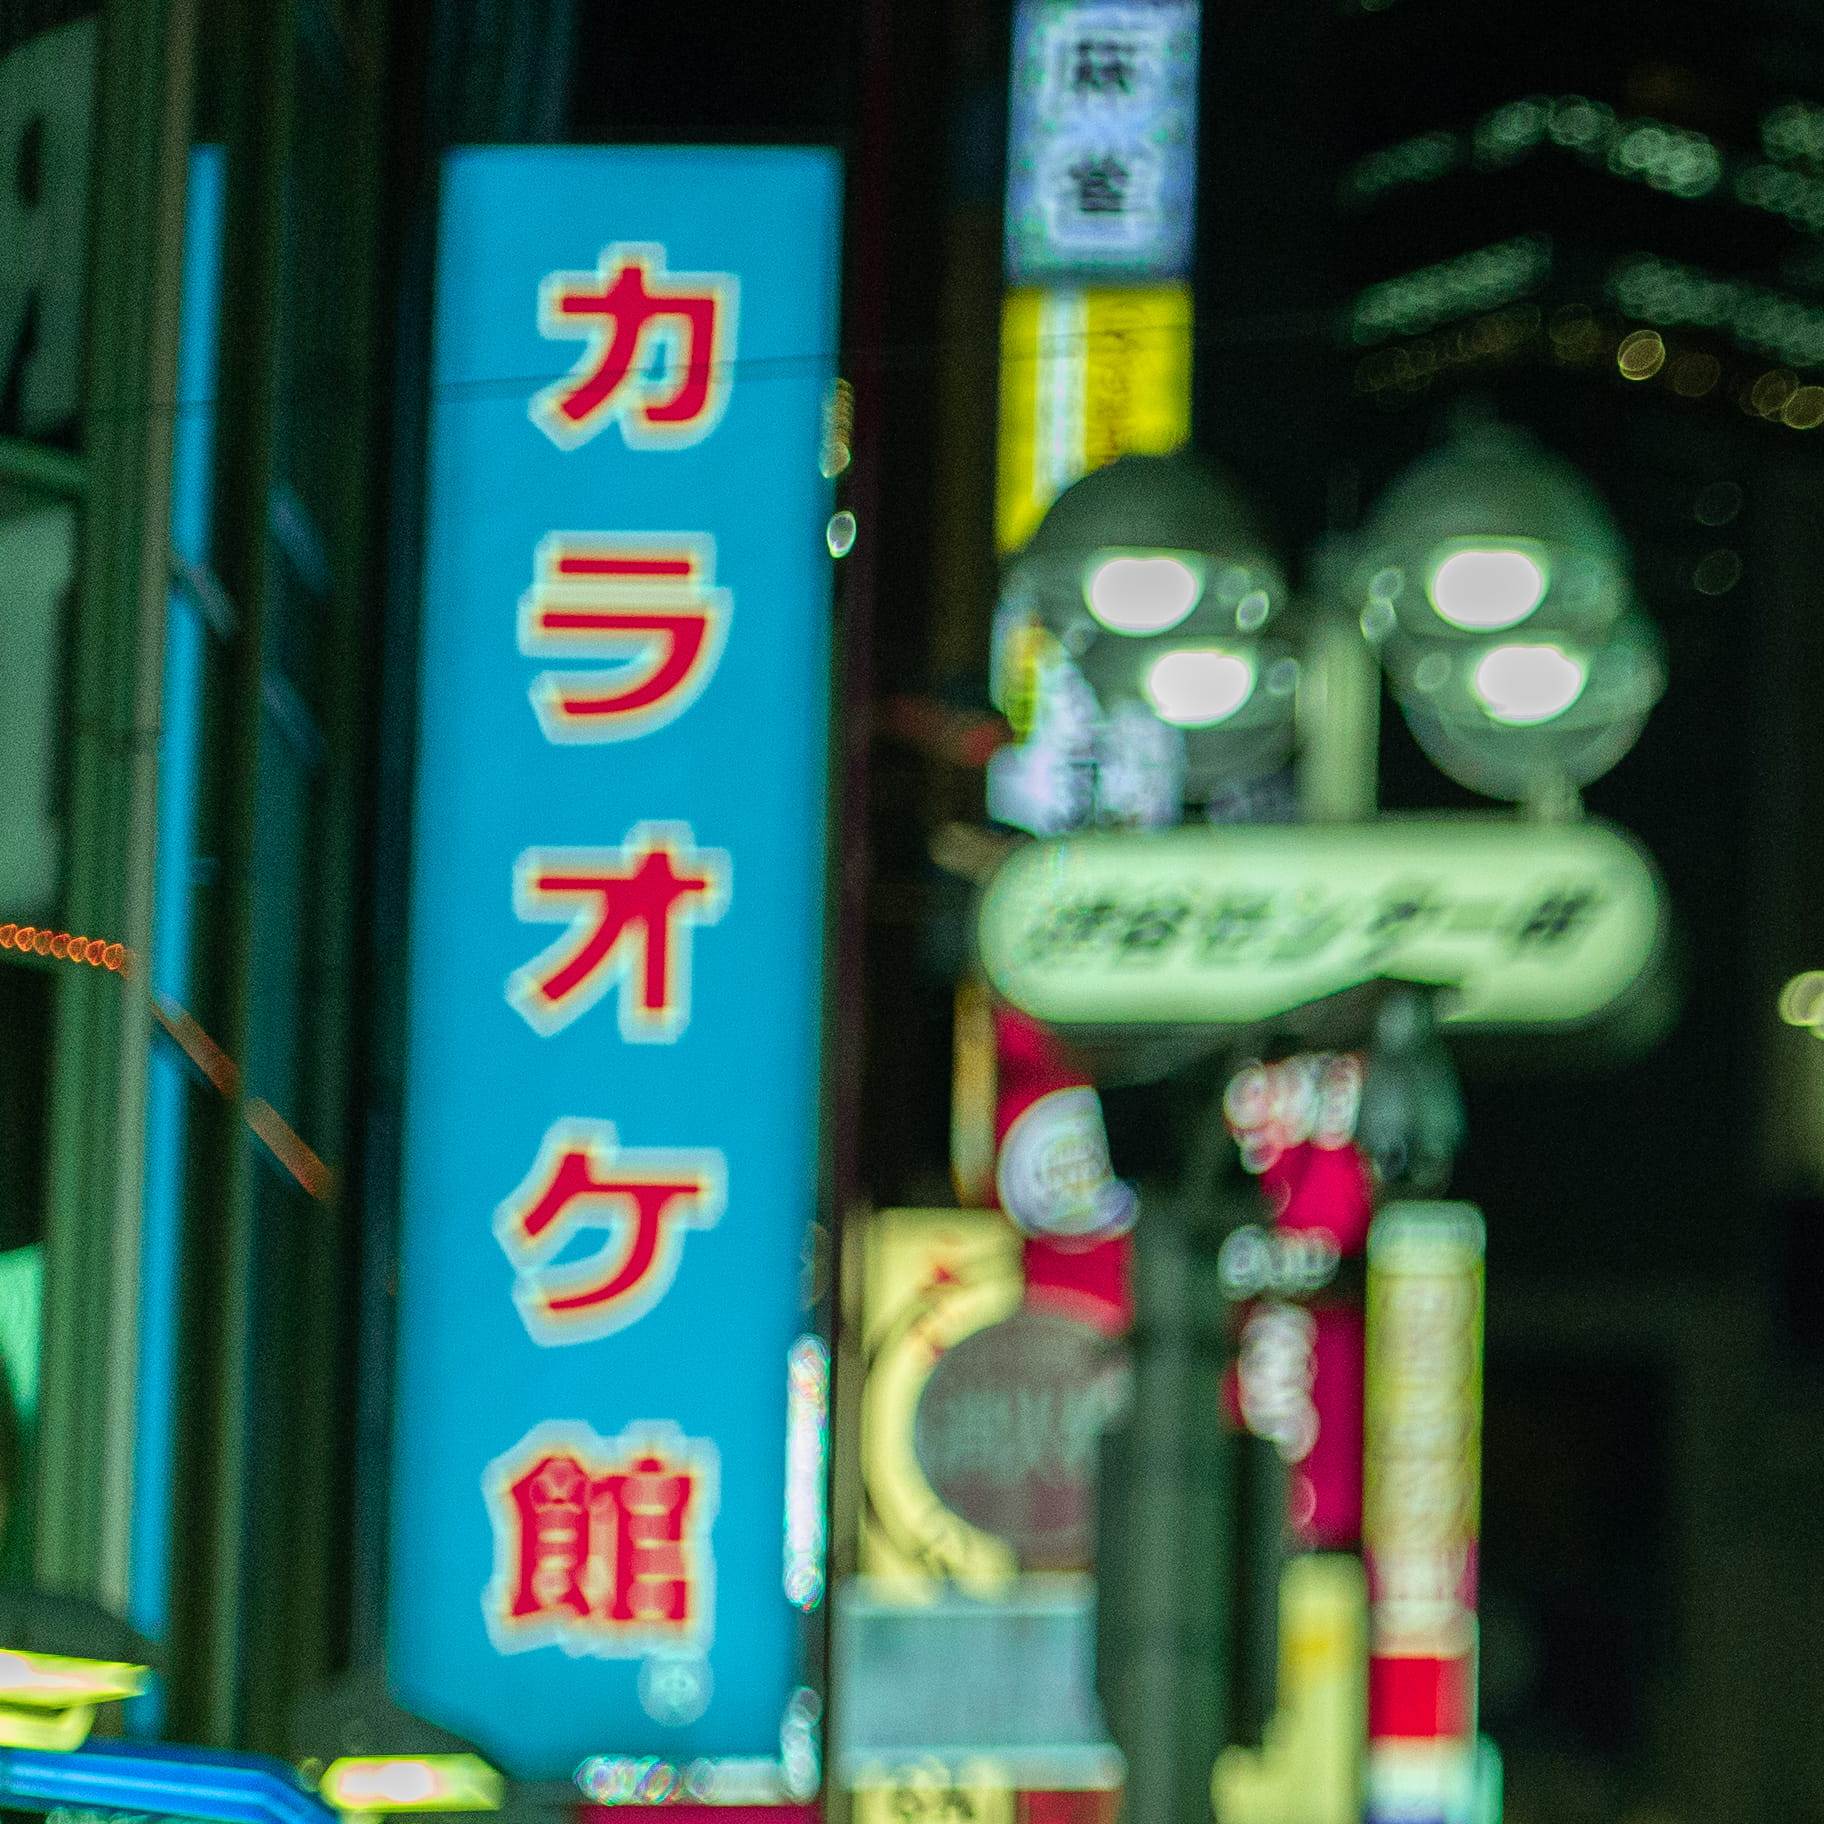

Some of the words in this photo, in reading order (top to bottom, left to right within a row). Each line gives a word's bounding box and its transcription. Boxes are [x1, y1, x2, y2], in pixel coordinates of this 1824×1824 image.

[485, 243, 740, 1652] カラオケ館
